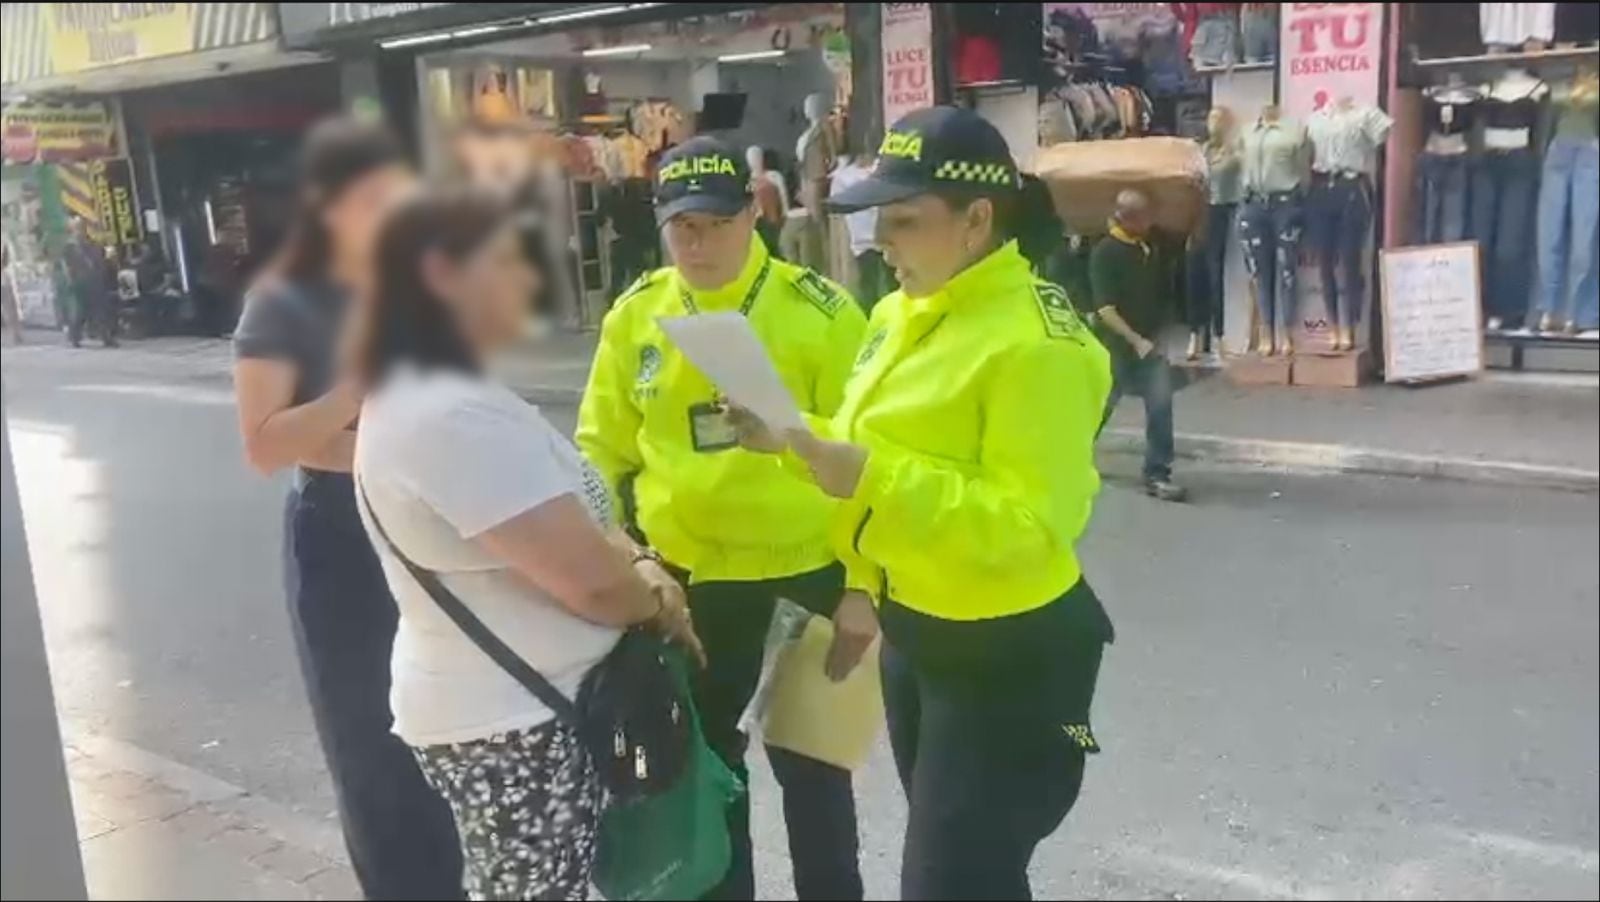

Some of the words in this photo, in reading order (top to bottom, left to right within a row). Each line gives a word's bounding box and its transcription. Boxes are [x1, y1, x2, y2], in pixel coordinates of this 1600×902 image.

[1290, 13, 1371, 53] TU
[887, 49, 927, 64] LUCE
[1291, 55, 1370, 75] ESENCIA
[888, 67, 928, 90] TU
[658, 154, 736, 186] POLICÍA
